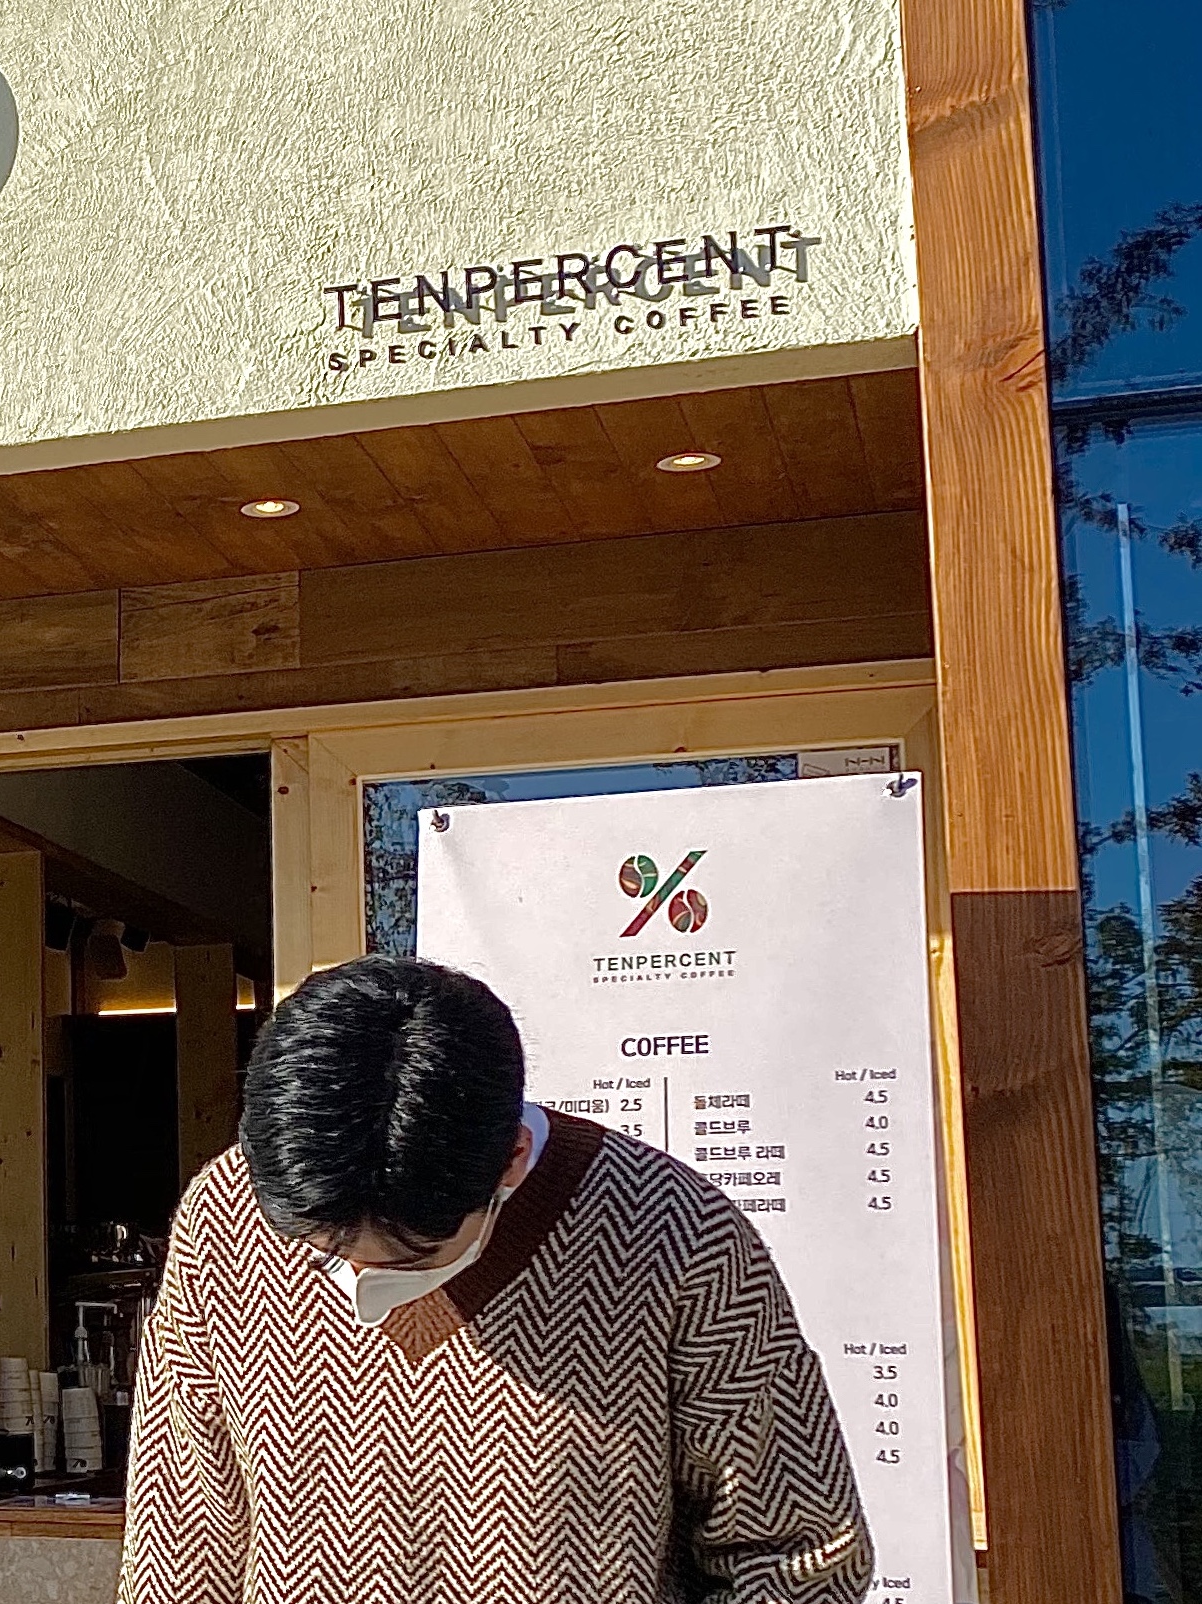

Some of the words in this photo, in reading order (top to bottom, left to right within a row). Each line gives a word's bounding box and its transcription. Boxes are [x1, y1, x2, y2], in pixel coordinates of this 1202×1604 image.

[324, 224, 791, 331] TENPERCENT
[327, 322, 581, 372] SPECIALTY
[614, 295, 791, 335] COFFEE
[593, 950, 737, 973] TENPERCENT
[593, 972, 672, 984] SPECIALTY
[680, 969, 736, 980] COFFEE
[620, 1034, 709, 1057] COFFEE
[835, 1070, 856, 1082] Hot
[869, 1068, 898, 1081] Iced
[593, 1079, 614, 1090] Hot
[626, 1078, 652, 1089] Iced
[863, 1089, 889, 1104] 4.5
[620, 1098, 643, 1112] 2.5
[694, 1120, 751, 1136] 콜드브루
[865, 1115, 889, 1129] 4.0
[694, 1146, 751, 1162] 콜드브루
[755, 1145, 786, 1160] 라떼
[866, 1142, 891, 1157] 4.5
[702, 1171, 781, 1187] 당카페오레
[867, 1169, 892, 1184] 4.5
[867, 1196, 892, 1211] 4.5
[843, 1343, 867, 1355] Hot
[879, 1343, 908, 1356] Iced
[873, 1365, 897, 1380] 3.5
[874, 1393, 899, 1408] 4.0
[875, 1421, 900, 1435] 4.0
[876, 1449, 901, 1464] 4.5
[882, 1577, 911, 1590] Iced
